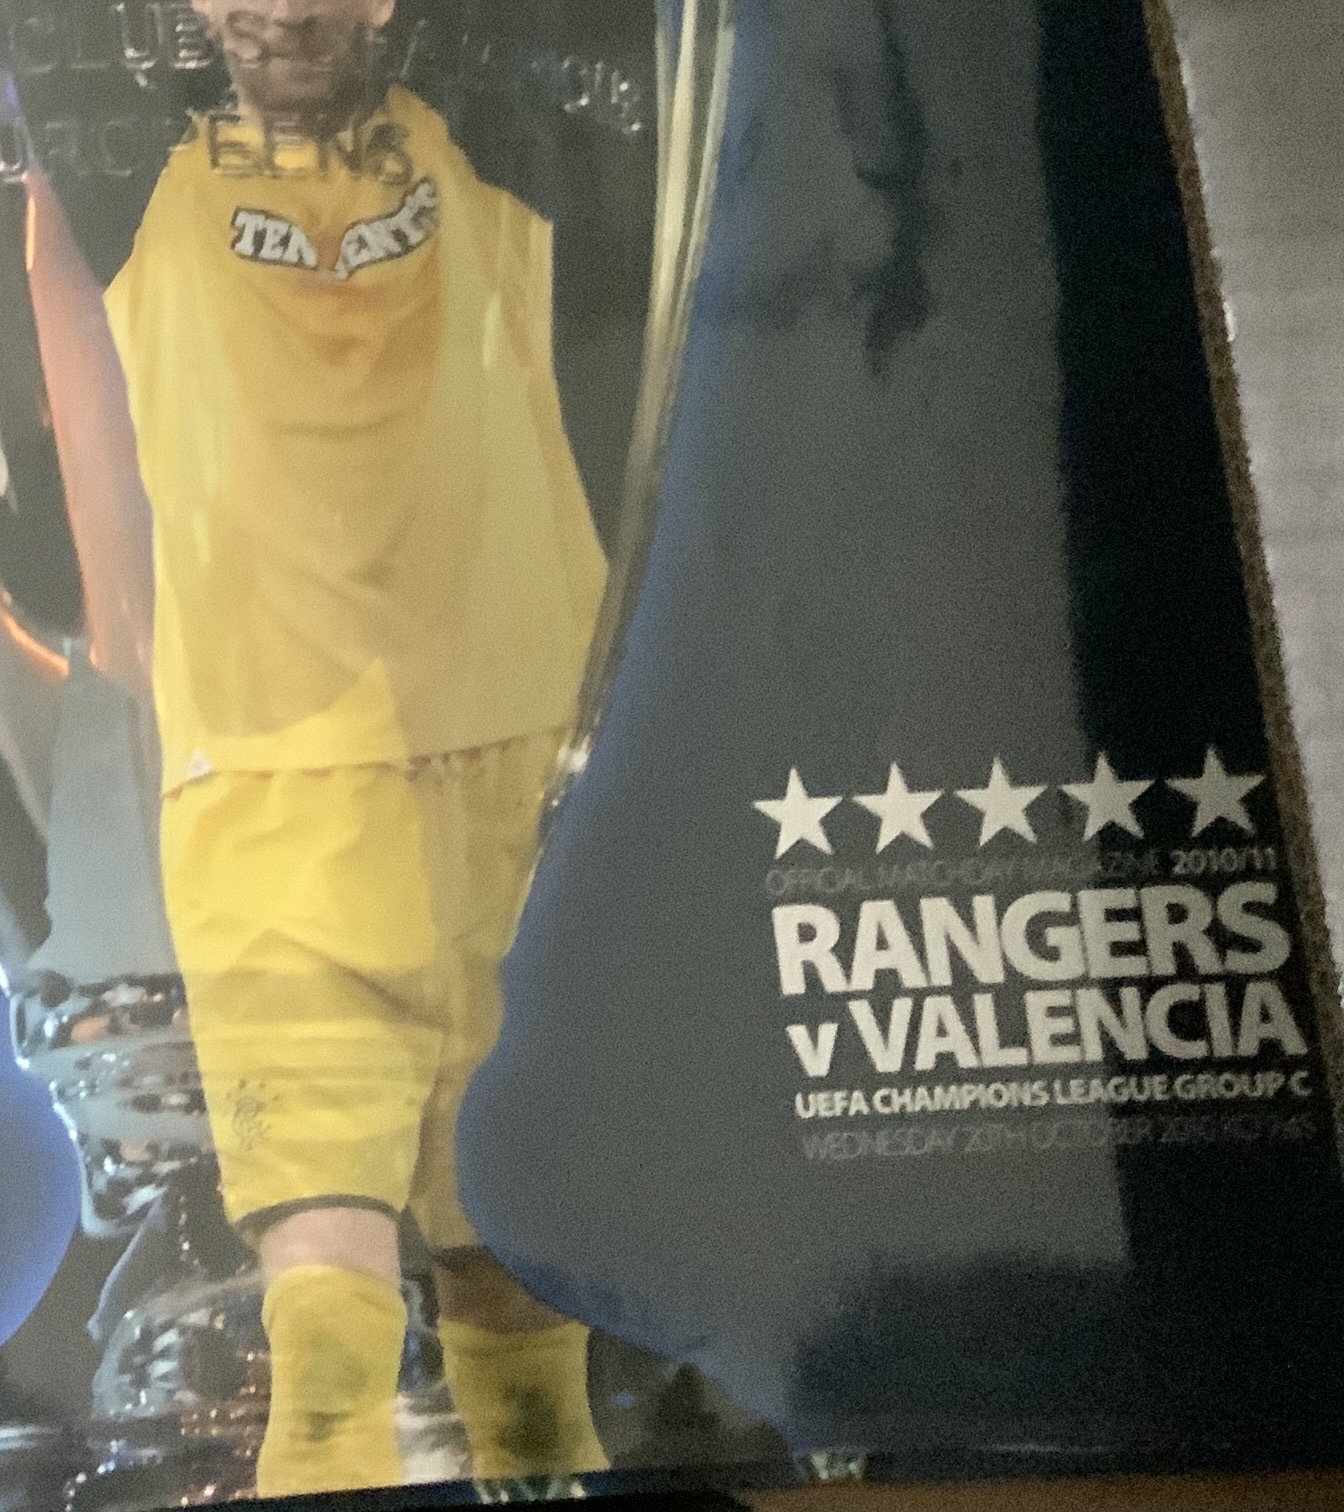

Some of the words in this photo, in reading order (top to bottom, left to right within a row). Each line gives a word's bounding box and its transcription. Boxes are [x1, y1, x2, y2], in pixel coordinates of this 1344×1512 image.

[1169, 846, 1279, 876] 2010/11
[770, 881, 1292, 997] RANGERS
[847, 981, 1310, 1074] VALENCIA
[794, 1088, 870, 1119] UEFA
[872, 1078, 1050, 1116] CHAMPIONS
[1053, 1073, 1170, 1105] LEAGUE
[1173, 1070, 1286, 1101] GROUP
[1288, 1070, 1311, 1096] C
